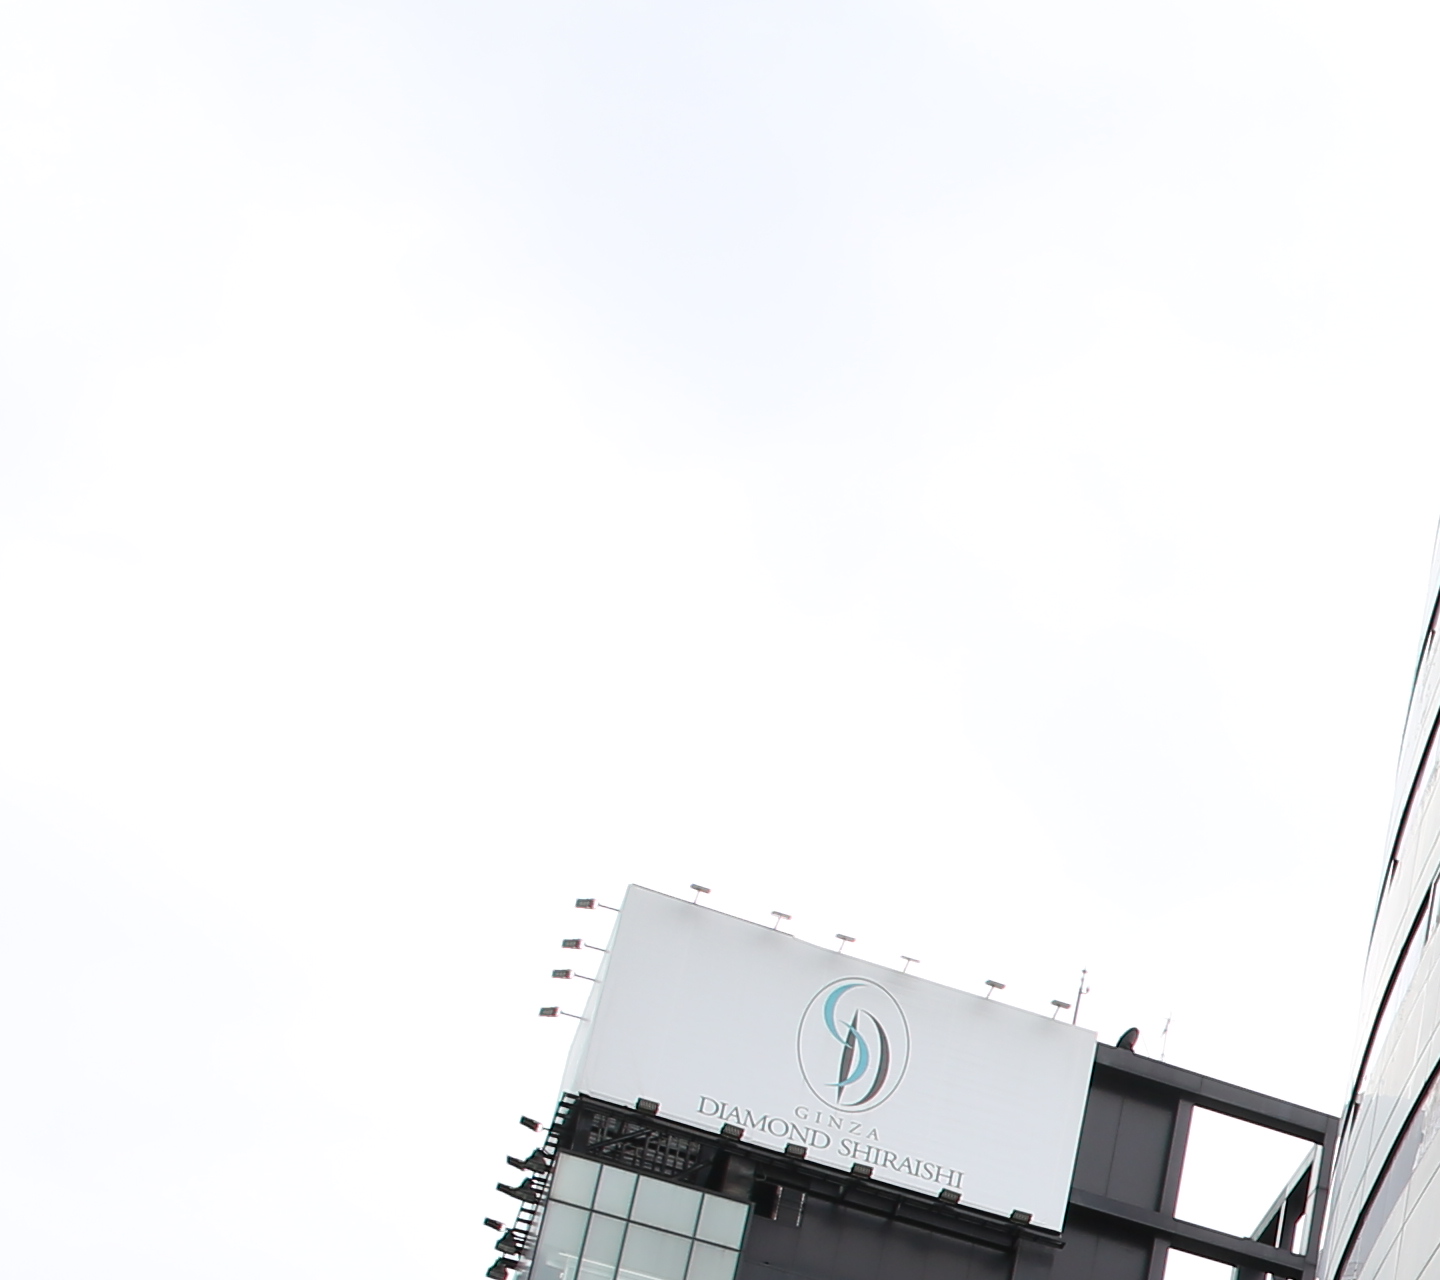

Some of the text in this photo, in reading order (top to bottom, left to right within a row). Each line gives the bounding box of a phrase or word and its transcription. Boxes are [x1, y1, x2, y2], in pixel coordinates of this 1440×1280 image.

[697, 1096, 965, 1189] DIAMOND SHIRAISHI
[795, 1106, 881, 1141] GINZA
